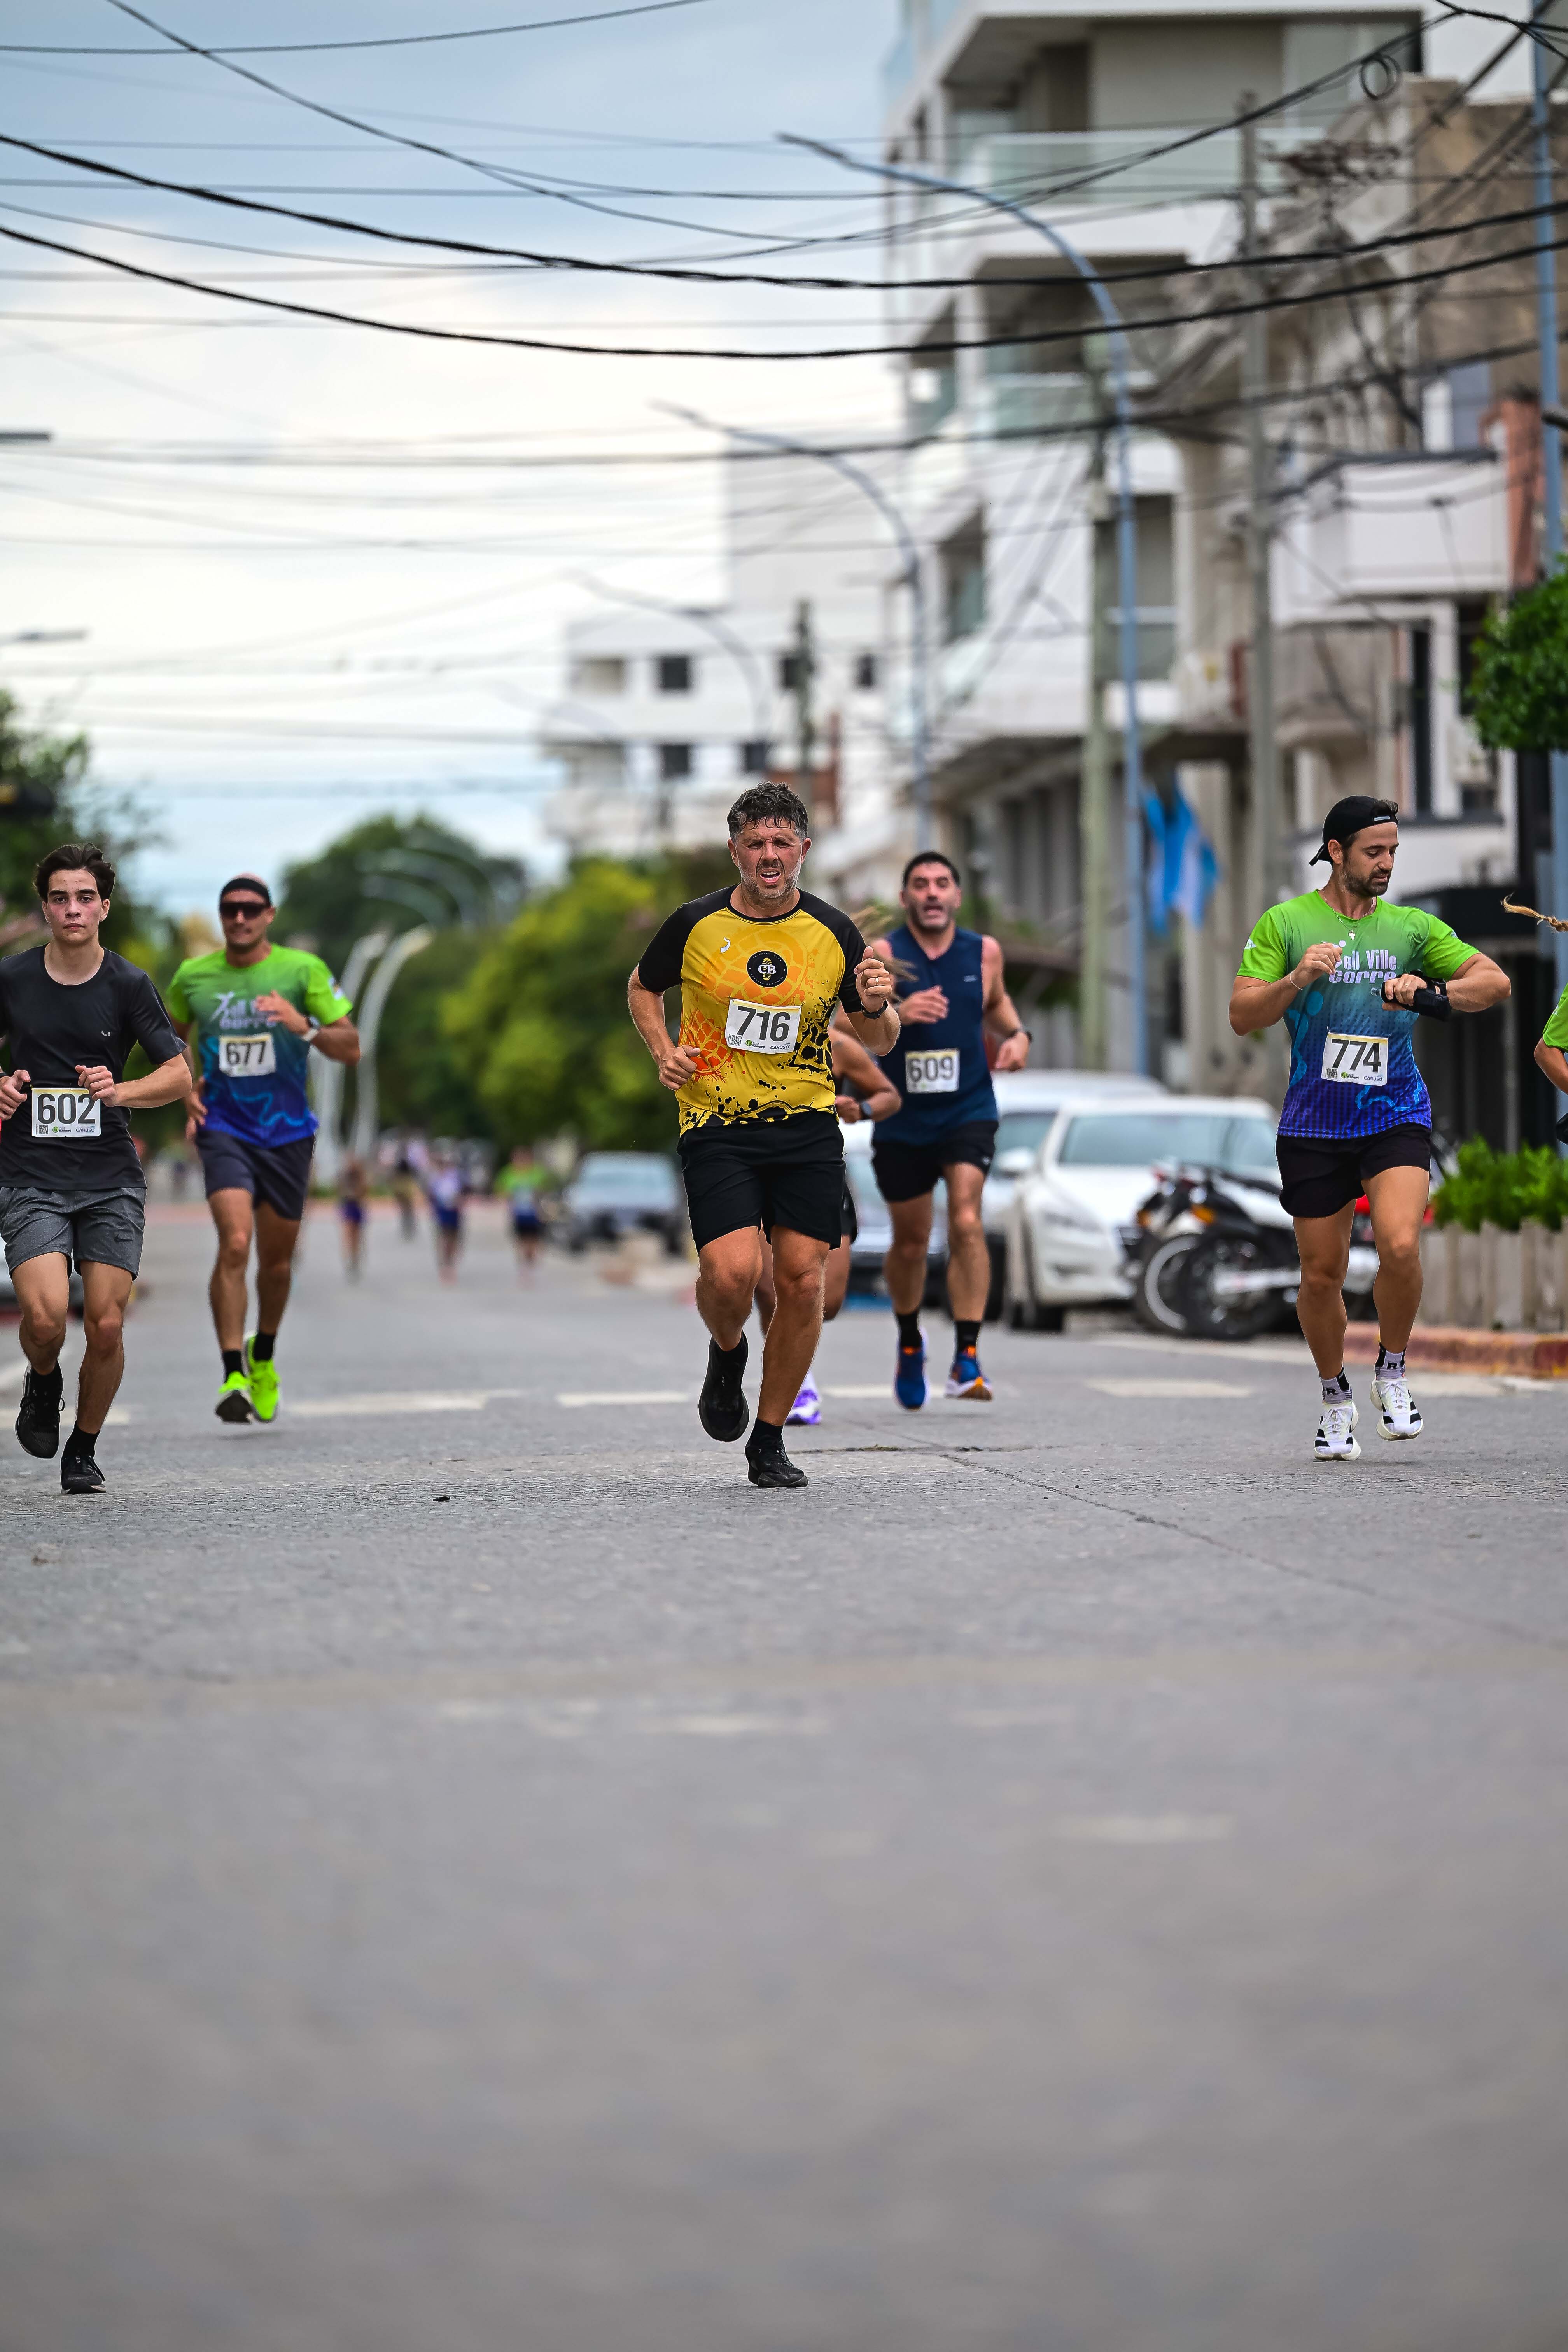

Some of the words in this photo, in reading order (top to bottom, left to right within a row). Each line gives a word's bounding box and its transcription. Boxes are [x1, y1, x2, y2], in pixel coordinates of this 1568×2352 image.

[758, 964, 776, 974] CB
[1335, 951, 1360, 970] ell
[1365, 950, 1397, 970] Ville
[737, 1006, 791, 1042] 716
[226, 1041, 266, 1065] 677
[1332, 1039, 1381, 1073] 774
[908, 1057, 953, 1082] 609
[38, 1093, 95, 1124] 602
